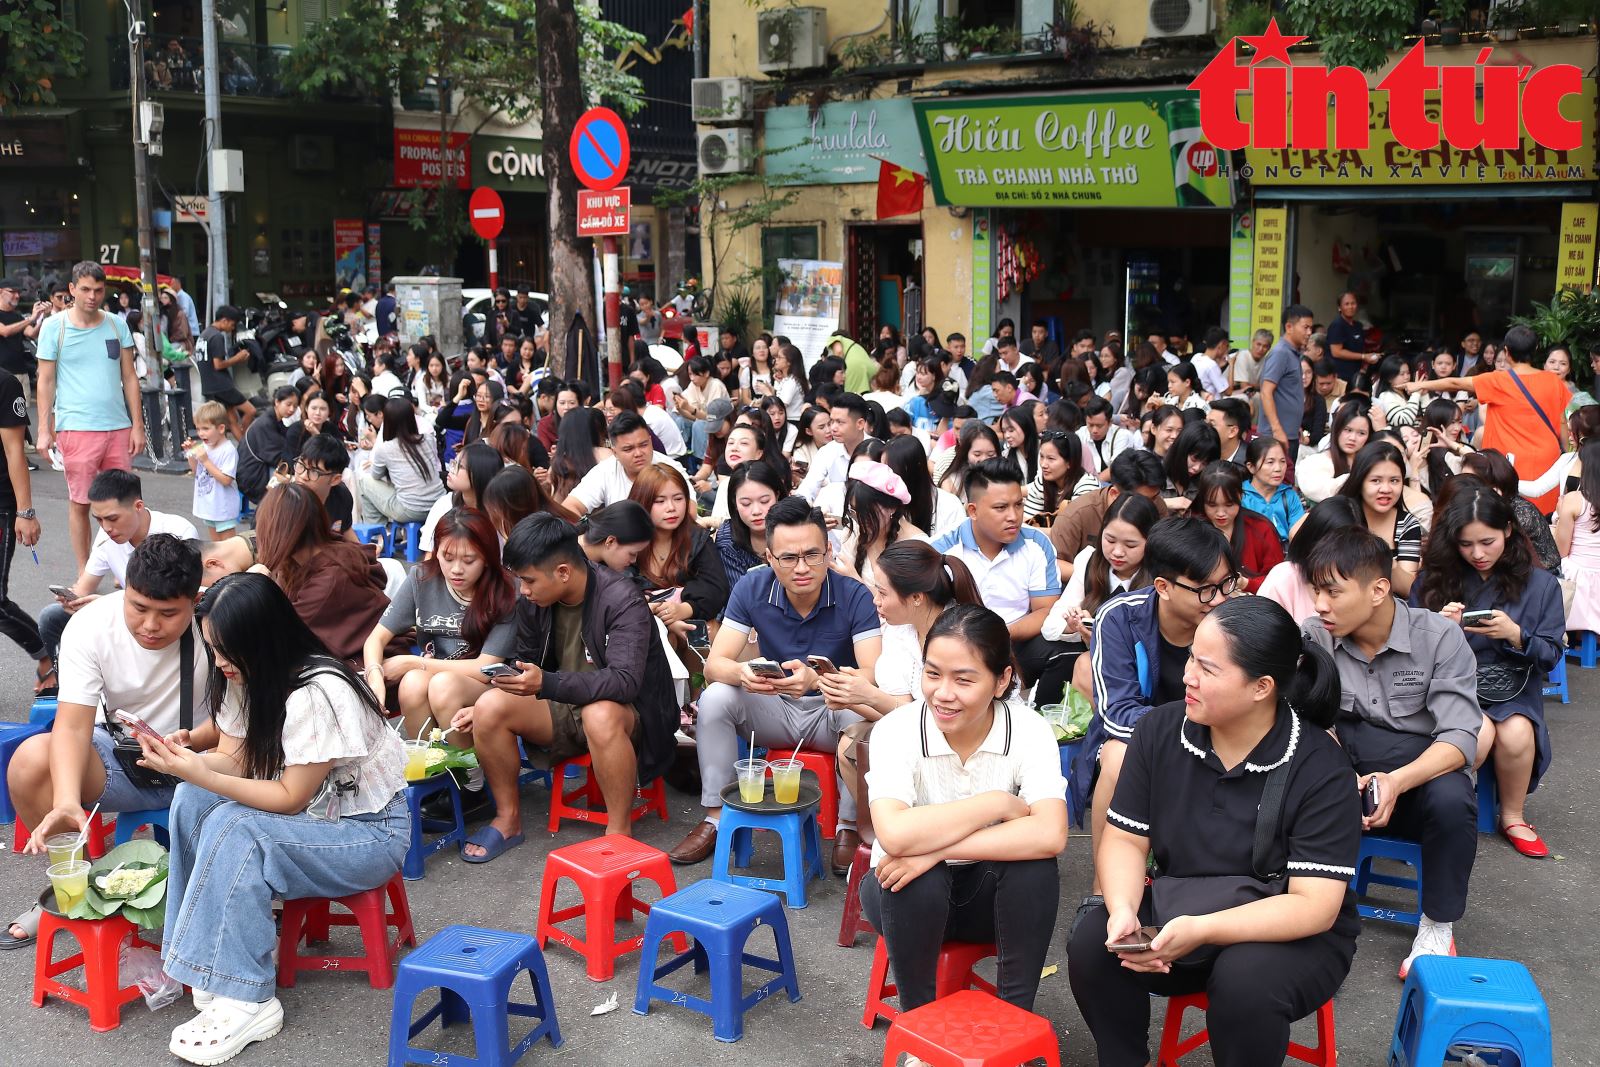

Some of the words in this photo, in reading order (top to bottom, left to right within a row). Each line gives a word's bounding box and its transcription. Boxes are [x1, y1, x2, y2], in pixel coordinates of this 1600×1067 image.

[934, 115, 1024, 153] Hiếu
[1035, 108, 1155, 160] Coffee
[421, 162, 466, 177] POSERS
[956, 164, 990, 185] TRÀ
[993, 168, 1054, 185] CHANH
[1058, 163, 1097, 185] NHÀ
[1100, 162, 1139, 185] THỜ
[586, 196, 603, 209] KHU
[1044, 191, 1051, 201] 2
[1072, 191, 1102, 201] CHUNG
[614, 215, 625, 227] XE
[100, 244, 119, 264] 27
[1373, 909, 1396, 919] 24
